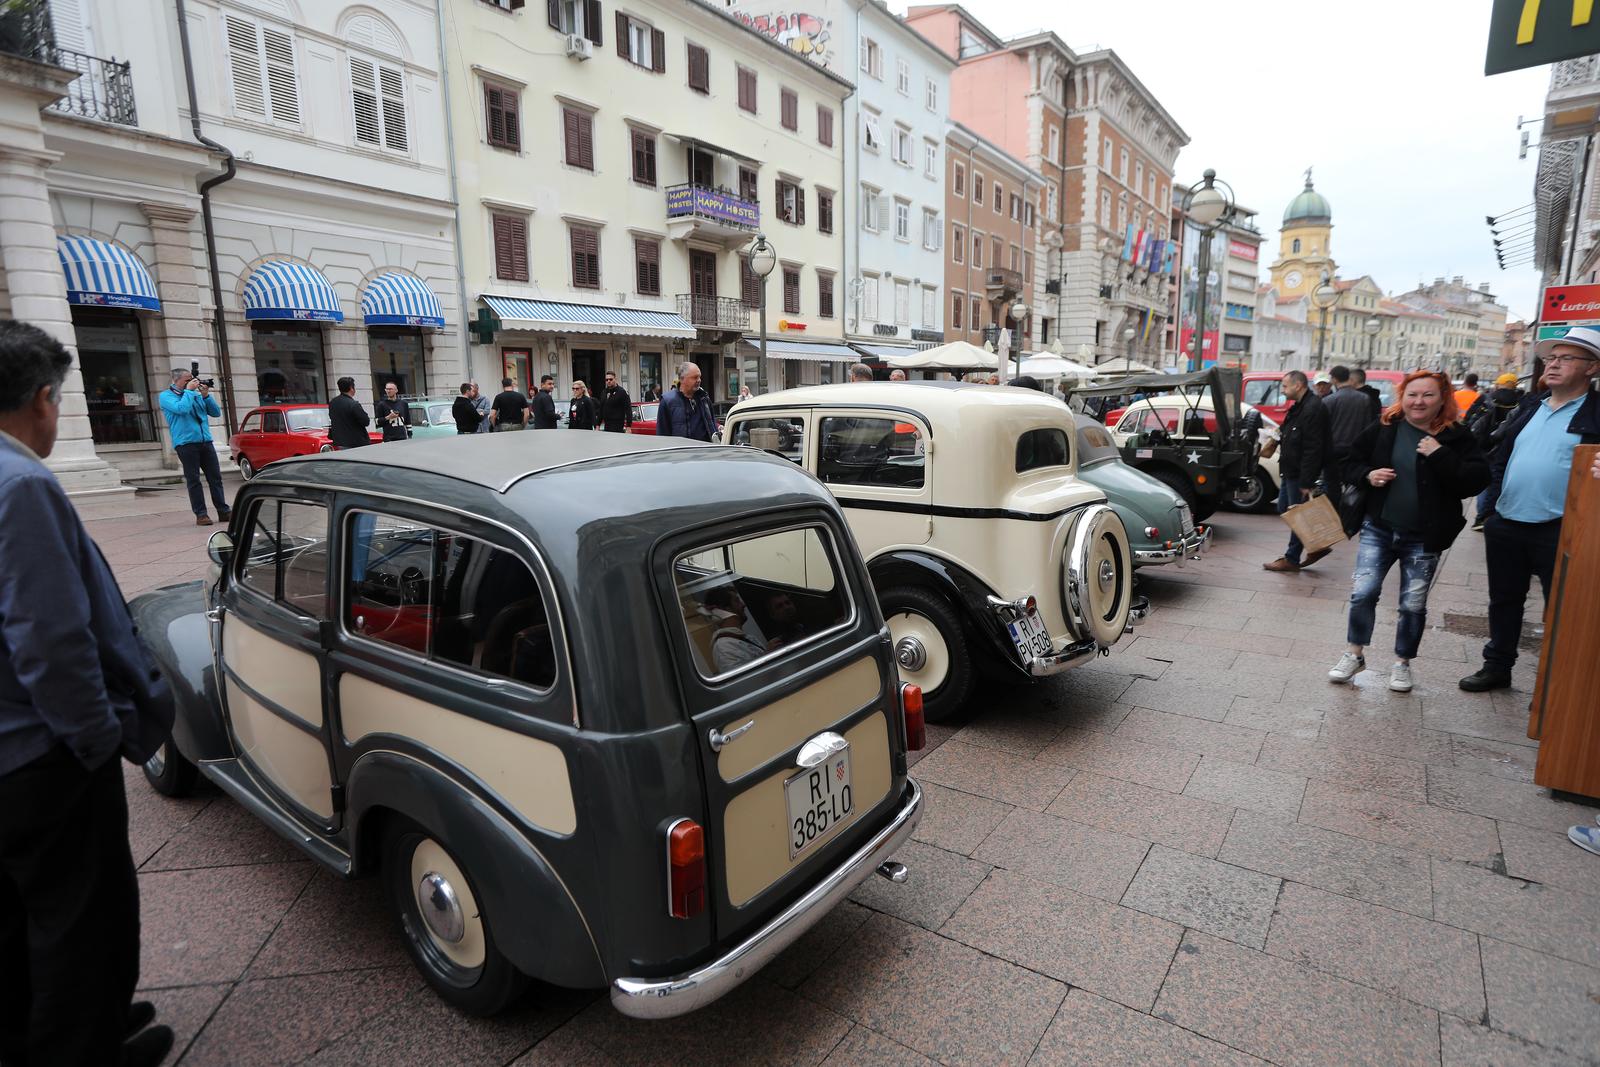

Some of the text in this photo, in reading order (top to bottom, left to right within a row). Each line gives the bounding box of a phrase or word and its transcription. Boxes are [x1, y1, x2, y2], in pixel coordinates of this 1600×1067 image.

[668, 200, 693, 209] HOSTEL
[669, 191, 692, 200] HAPPY
[697, 195, 757, 220] HAPPY HOSTEL
[1019, 617, 1035, 639] RI
[1019, 631, 1051, 663] PV-508
[809, 764, 830, 804] RI
[793, 784, 852, 849] 385-LO
